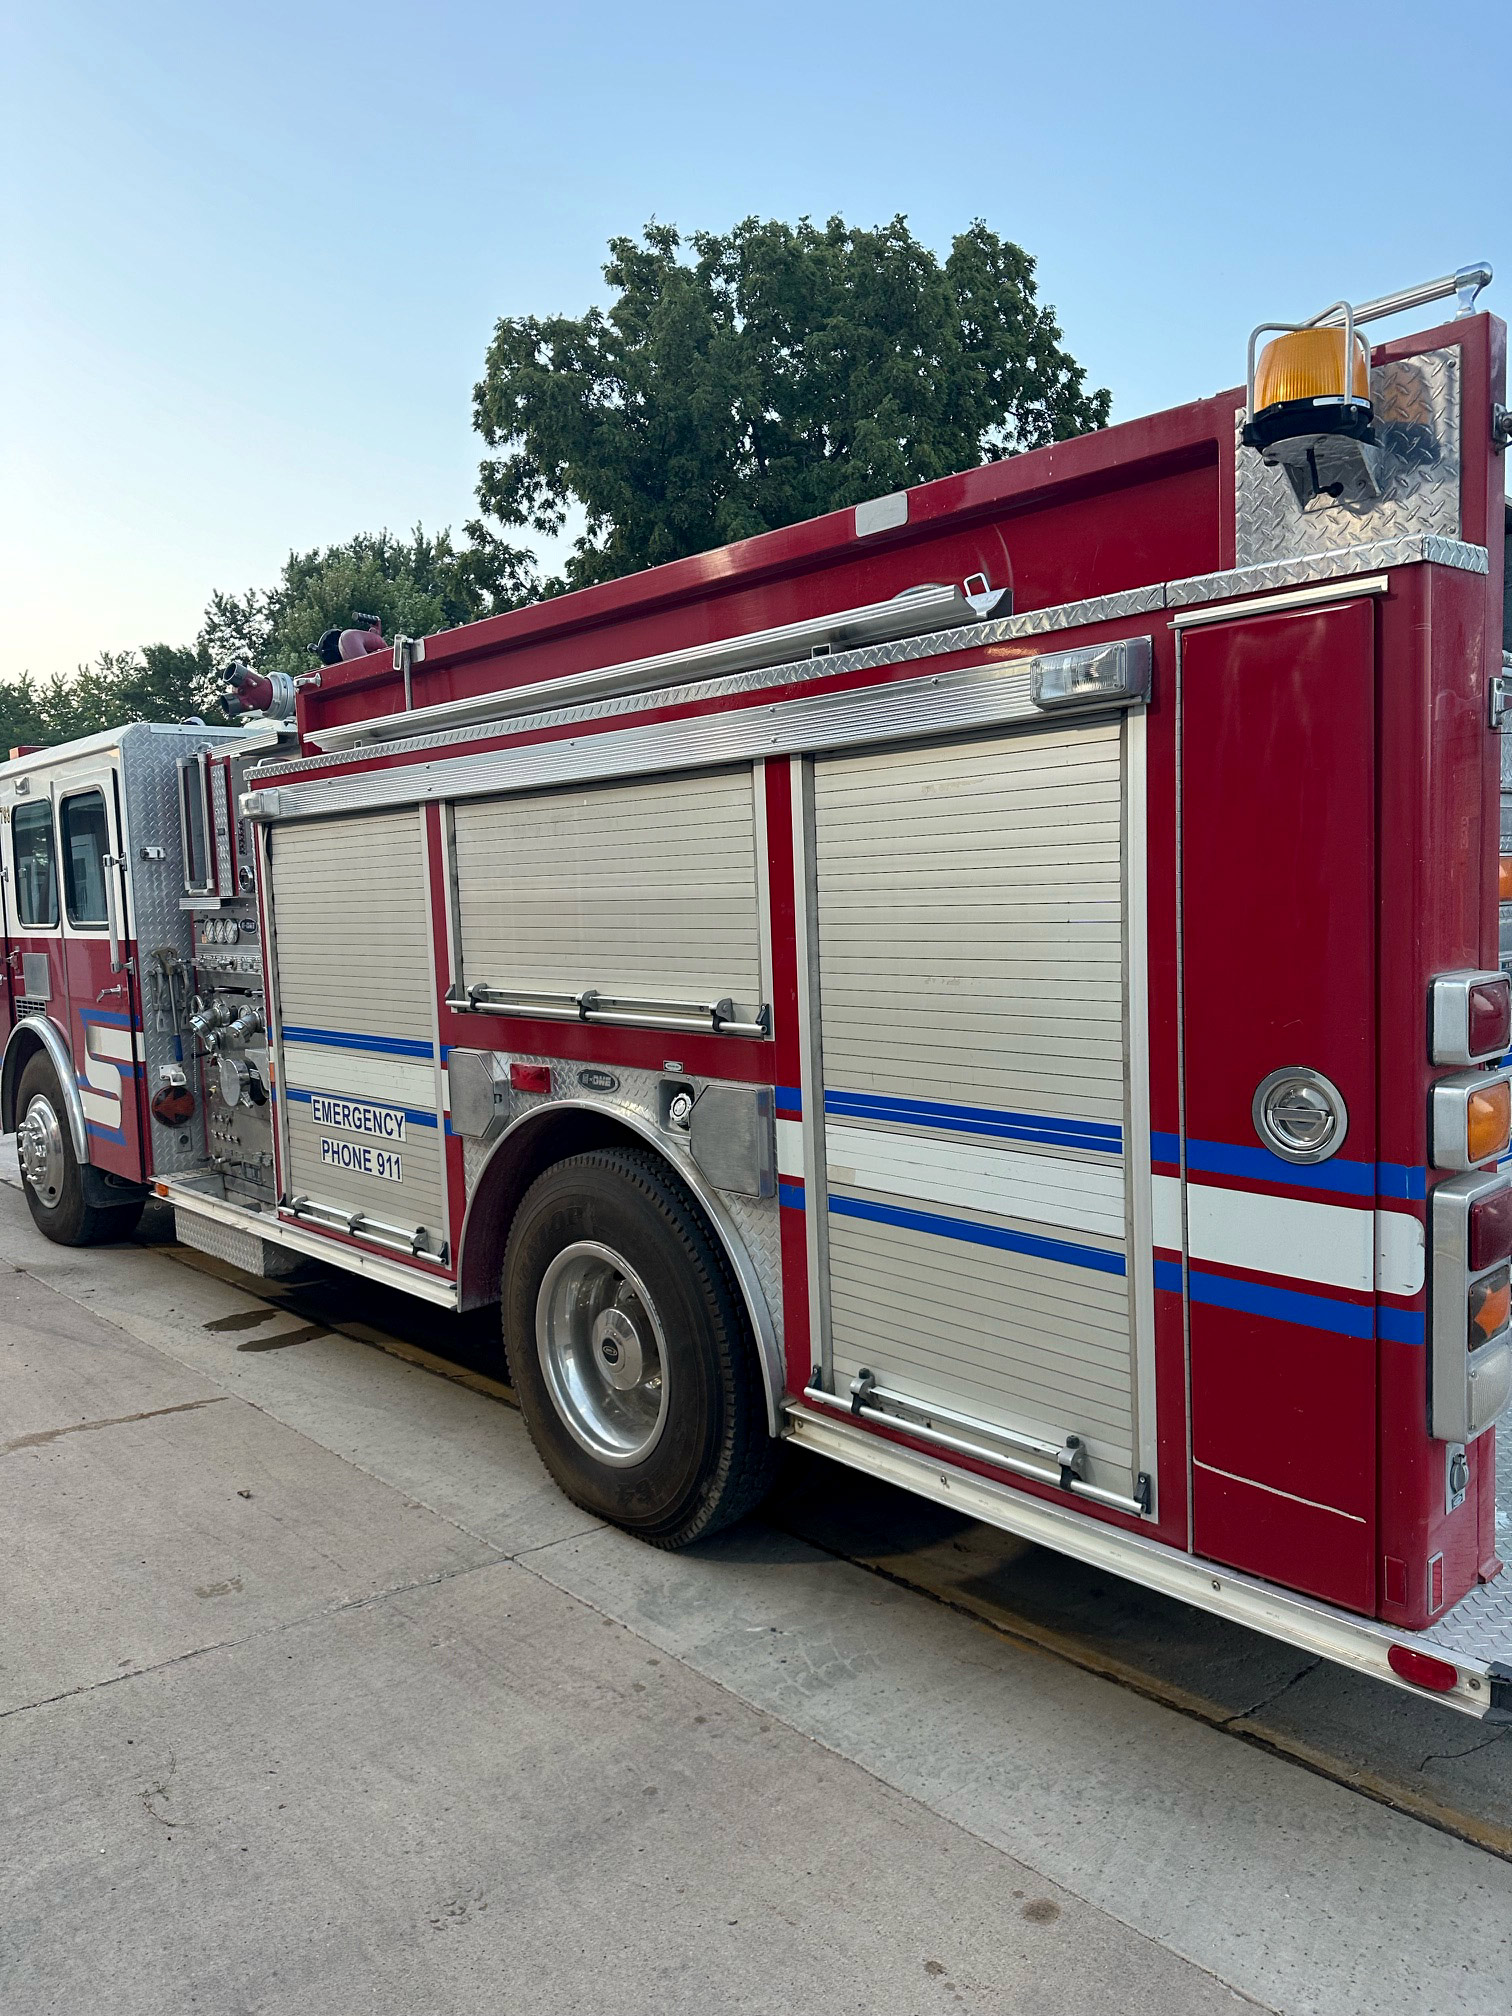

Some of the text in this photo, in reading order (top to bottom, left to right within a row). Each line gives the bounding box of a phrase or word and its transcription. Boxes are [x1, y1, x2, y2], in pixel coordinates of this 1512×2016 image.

[313, 1099, 404, 1138] EMERGENCY
[322, 1140, 401, 1180] PHONE 911
